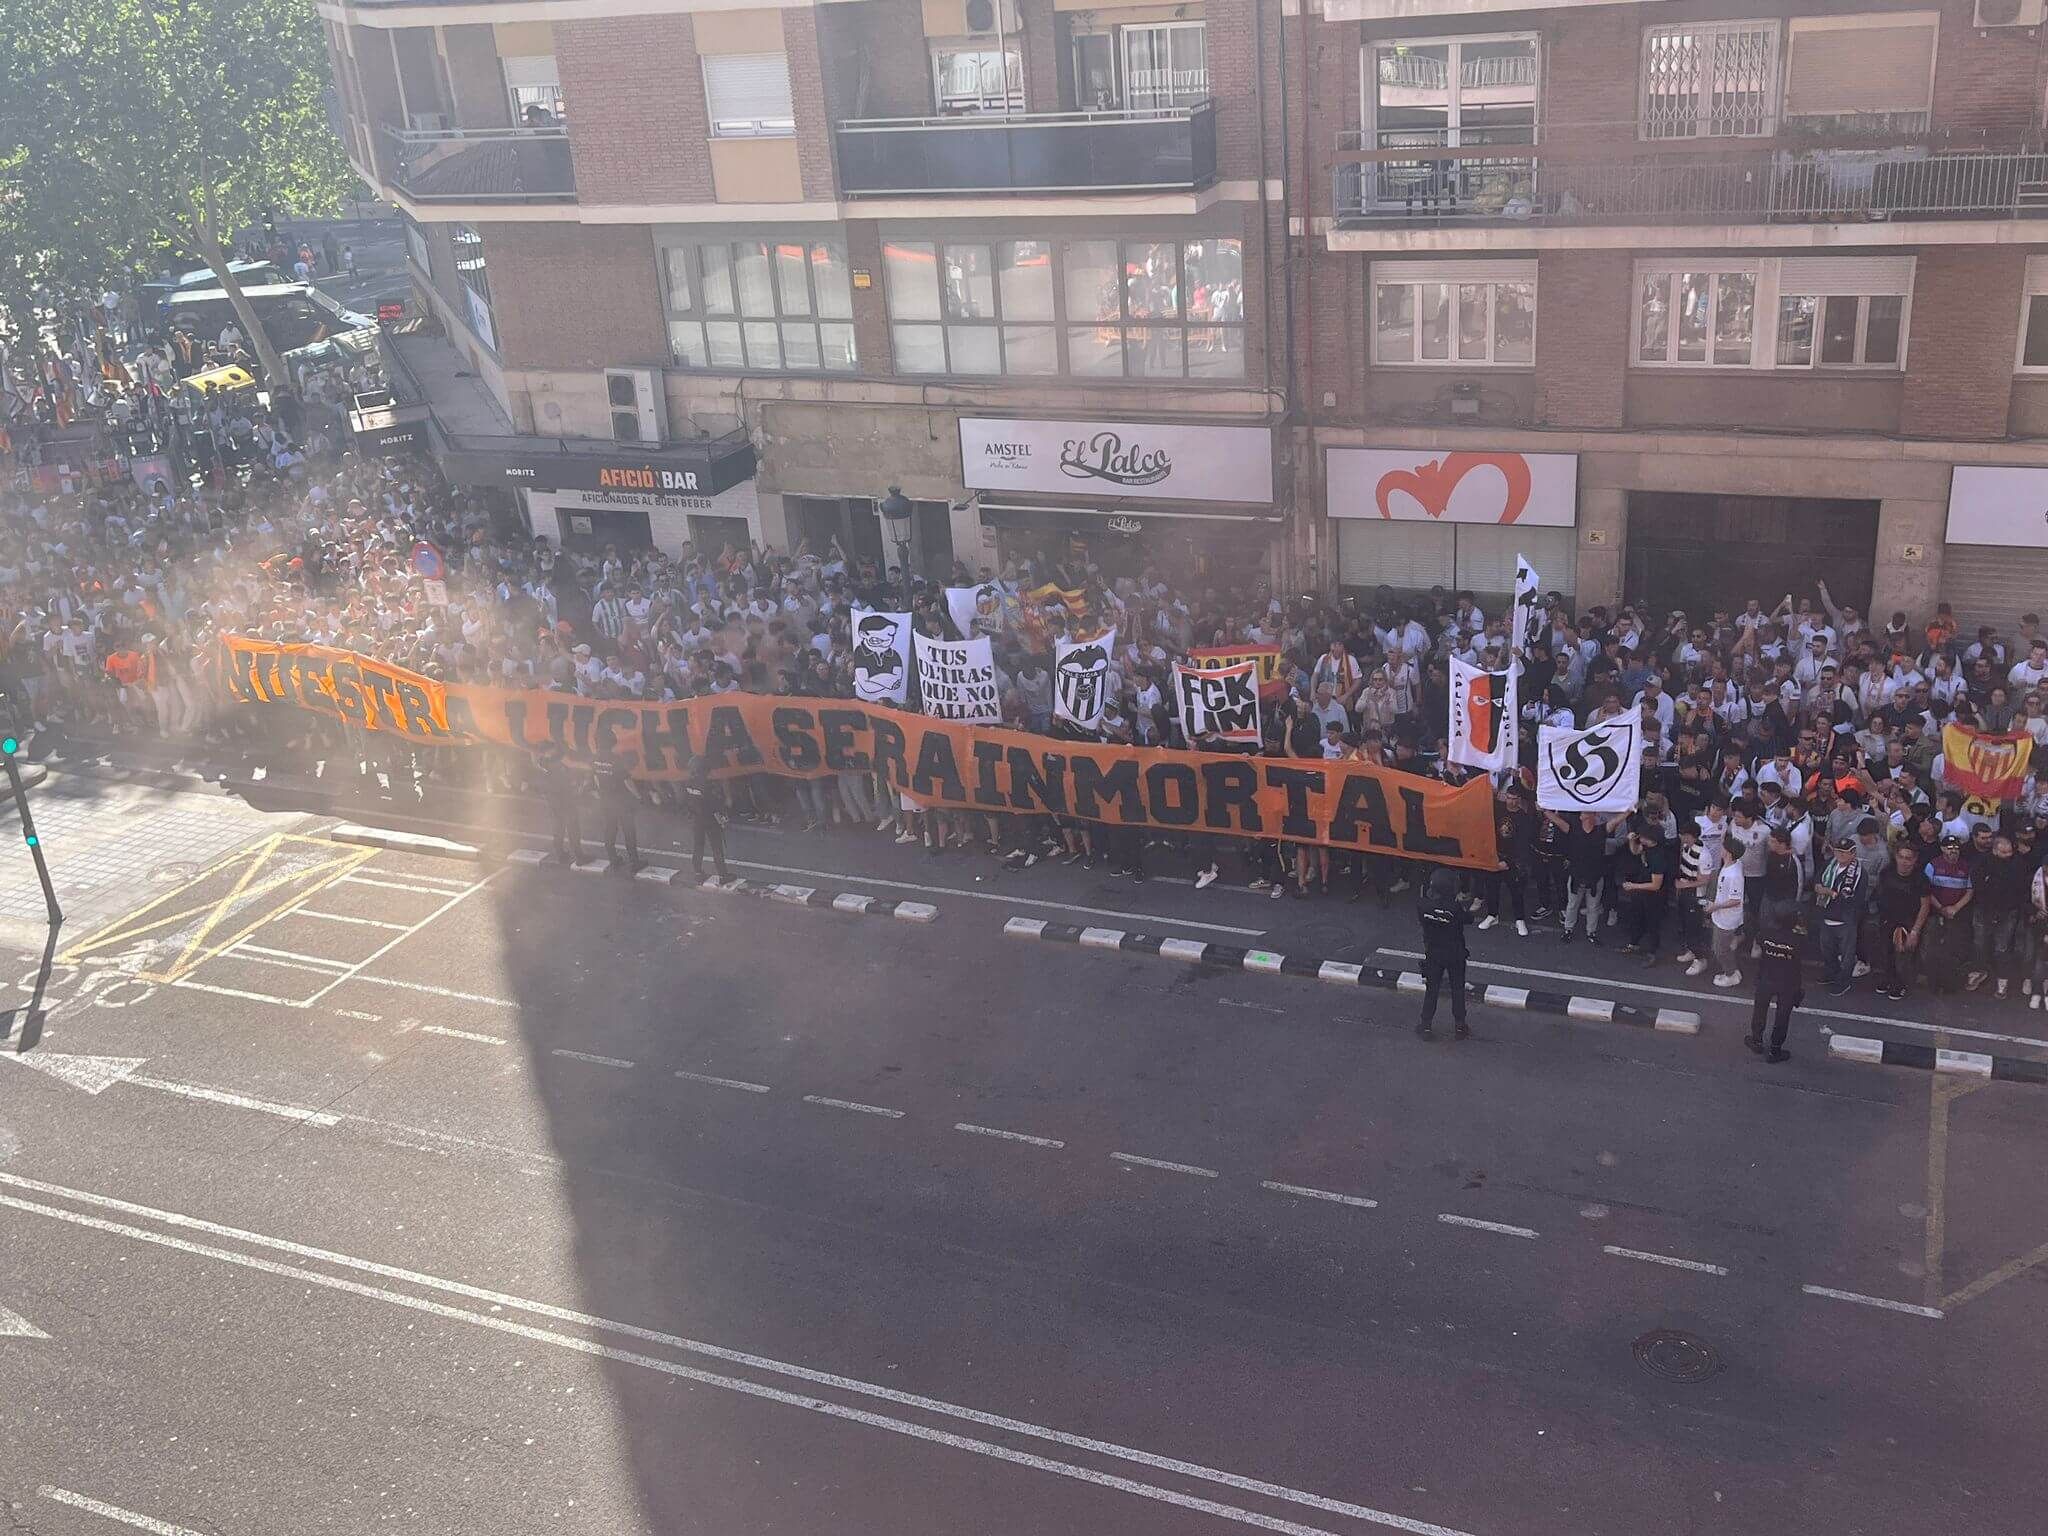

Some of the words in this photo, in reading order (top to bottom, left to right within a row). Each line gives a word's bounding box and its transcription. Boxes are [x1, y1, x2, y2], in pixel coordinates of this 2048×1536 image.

[380, 434, 413, 445] MORITZ
[985, 443, 1032, 456] AMSTEL
[1090, 431, 1171, 474] Palco
[506, 468, 535, 477] MORITZ
[600, 465, 655, 488] AFICIÓ
[661, 470, 699, 490] BAR
[582, 493, 640, 505] AFICIONADOS
[642, 496, 653, 506] AL
[681, 498, 713, 509] BEBER
[927, 646, 967, 665] TUS
[918, 658, 993, 684] ULTRAS
[922, 680, 959, 702] QUE
[965, 684, 995, 702] NO
[1181, 668, 1256, 711] FCK
[1455, 672, 1463, 737] APLASTA
[226, 650, 480, 740] NUESTRA
[505, 700, 763, 770] LUCHA
[772, 706, 966, 800] SERA
[974, 740, 1463, 858] INMORTAL
